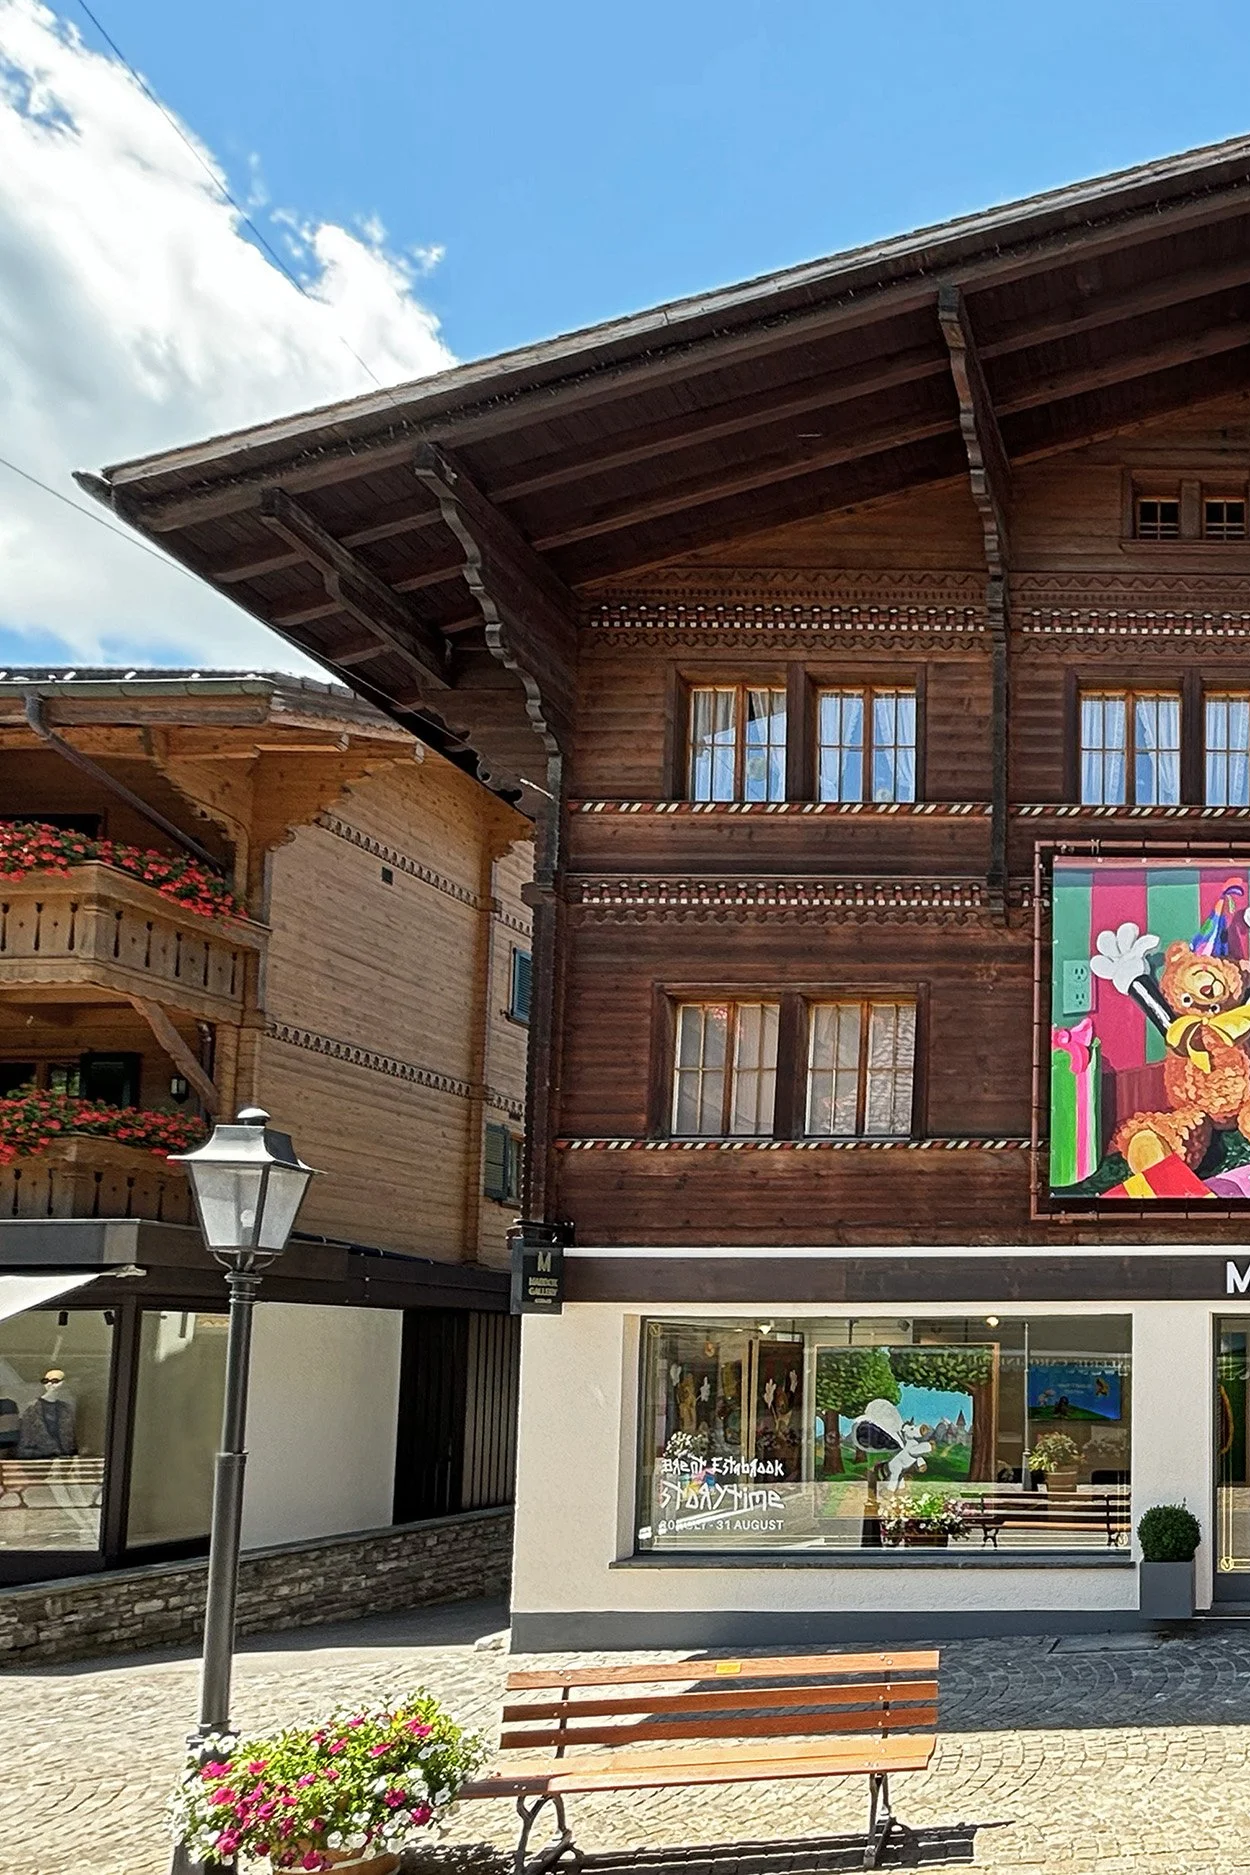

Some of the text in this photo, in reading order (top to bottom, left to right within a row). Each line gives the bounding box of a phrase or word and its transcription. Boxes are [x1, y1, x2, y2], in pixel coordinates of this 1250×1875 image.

[537, 1251, 551, 1272] M
[528, 1287, 558, 1297] GALLERY
[677, 1520, 707, 1530] ULY
[716, 1520, 731, 1530] 31
[734, 1520, 785, 1530] AUGUST
